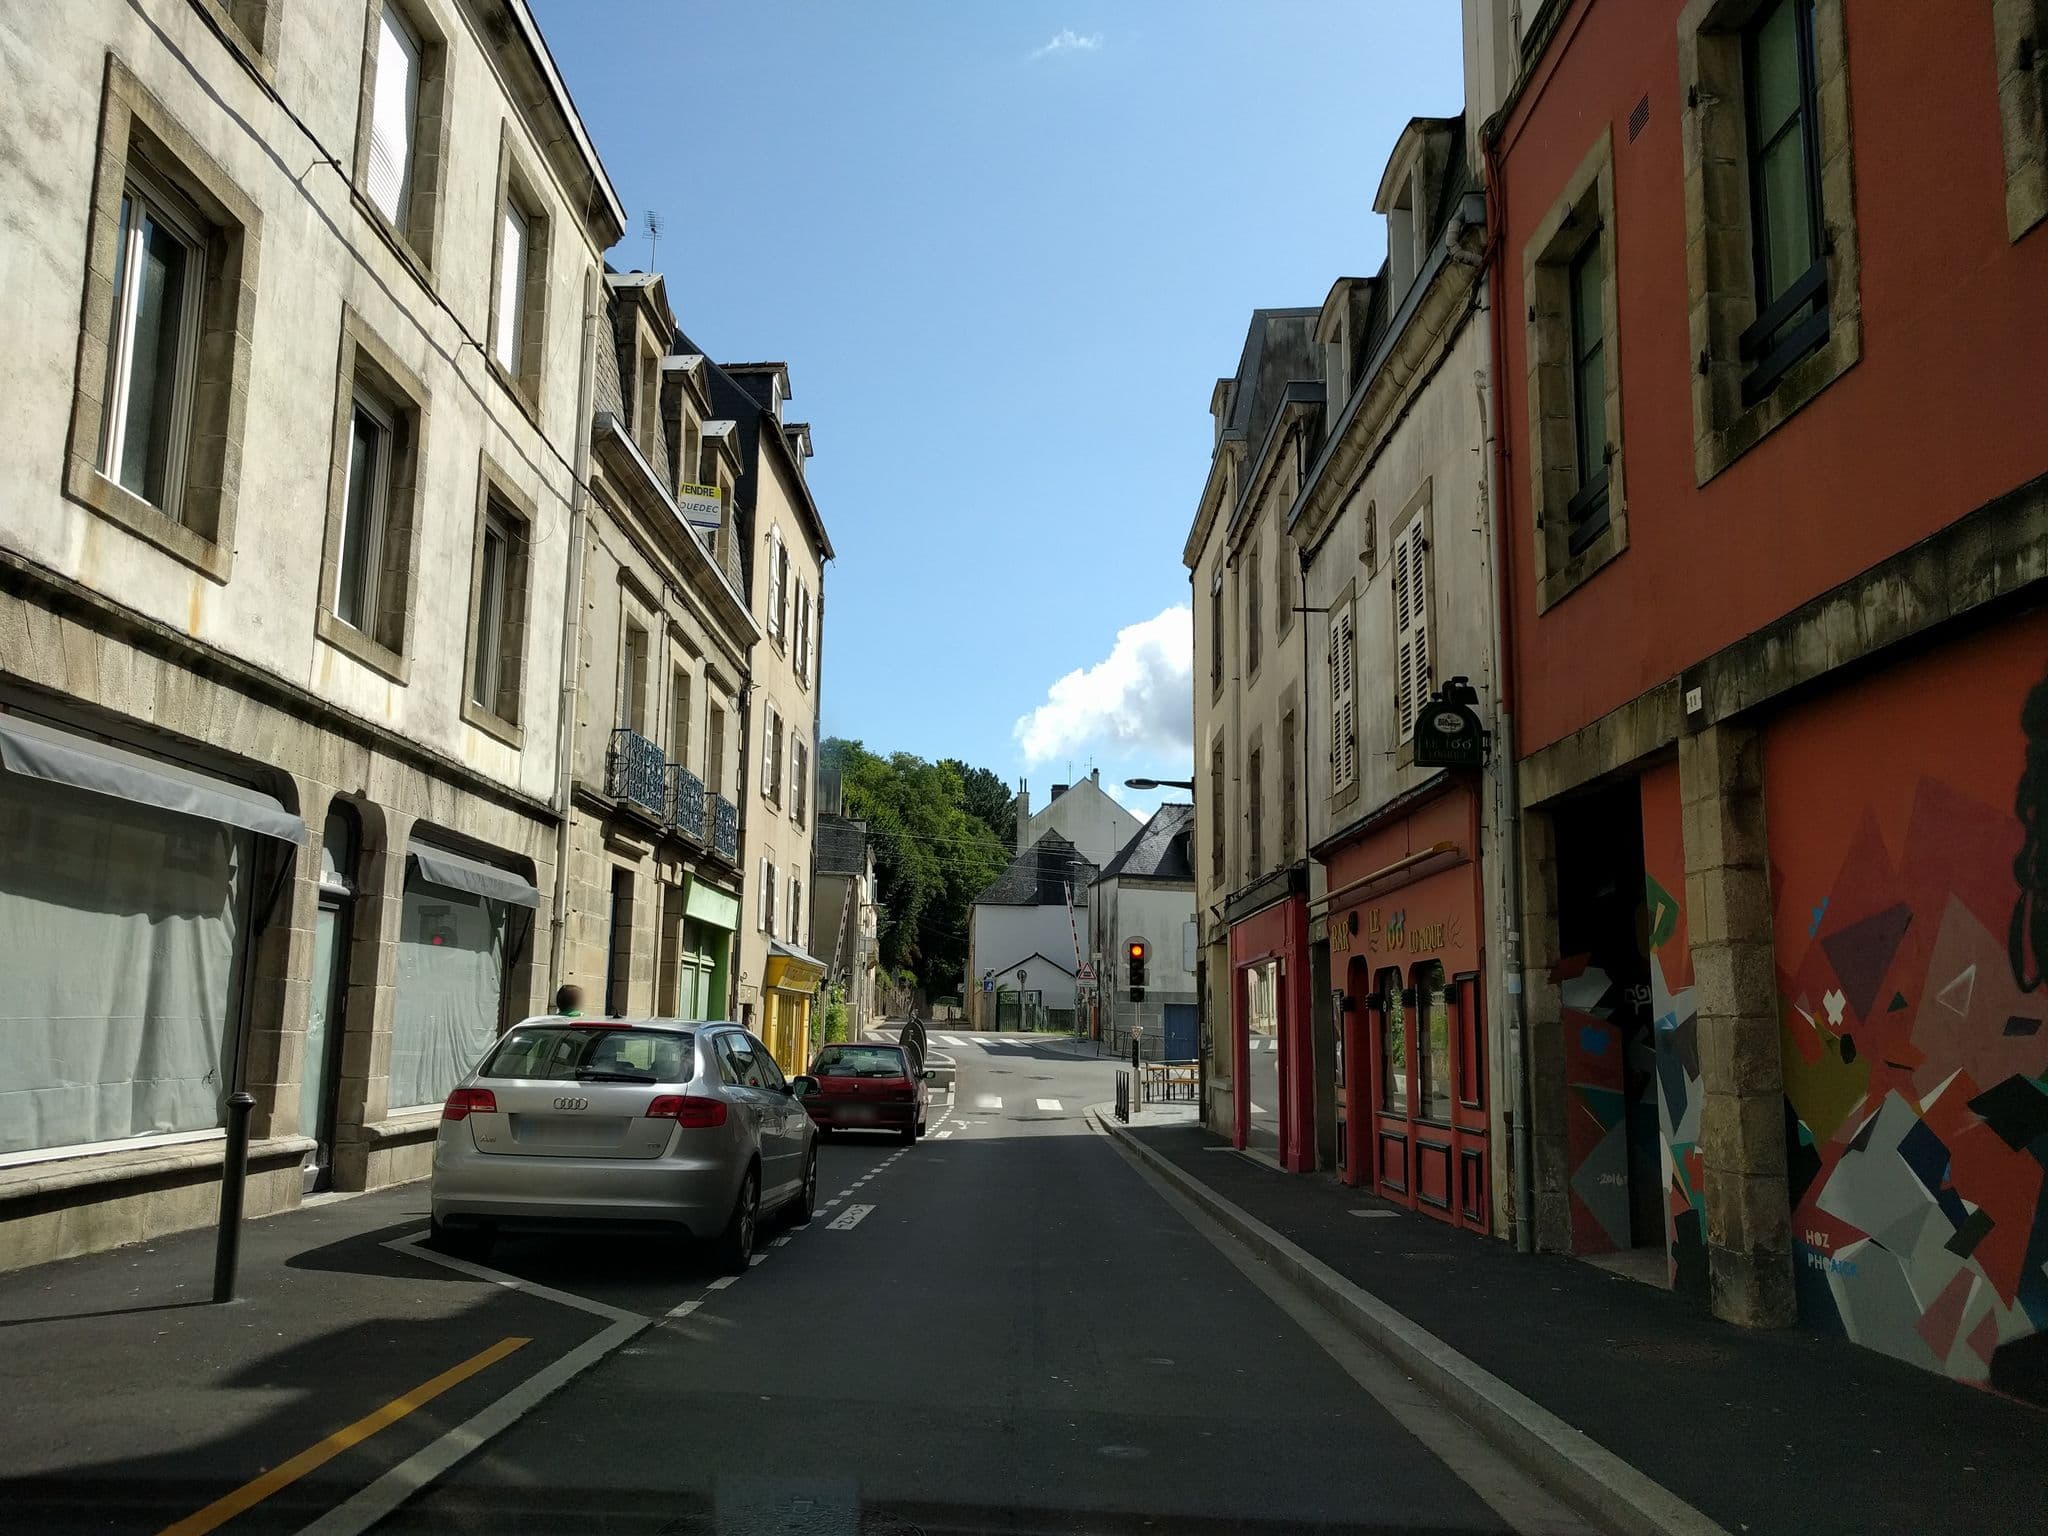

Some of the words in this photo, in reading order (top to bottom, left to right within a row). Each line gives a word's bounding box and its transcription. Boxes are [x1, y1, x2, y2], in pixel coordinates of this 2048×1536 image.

[1369, 908, 1381, 934] LE
[1331, 920, 1350, 953] BAR
[1805, 1229, 1830, 1249] HOZ
